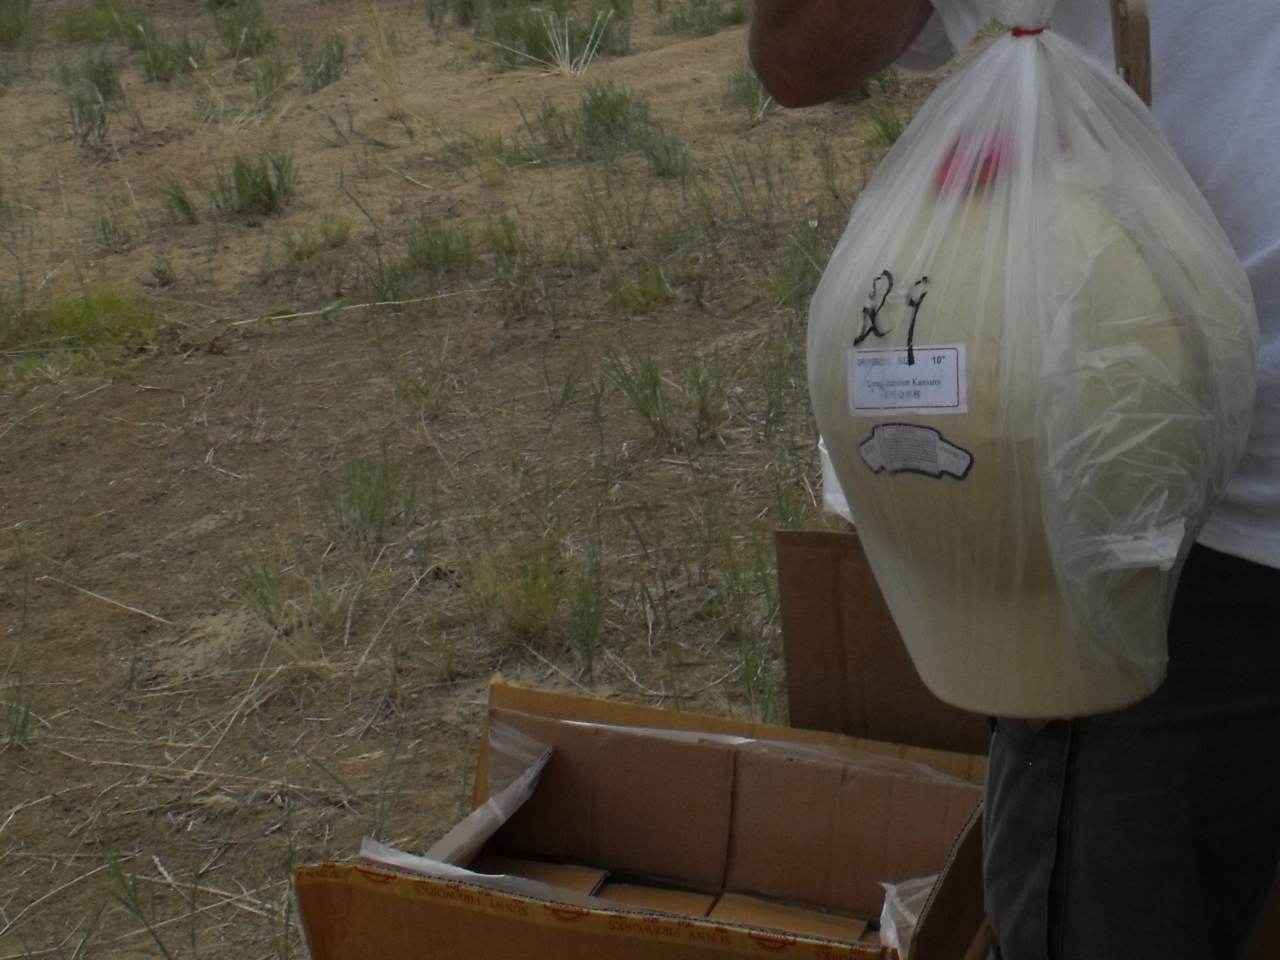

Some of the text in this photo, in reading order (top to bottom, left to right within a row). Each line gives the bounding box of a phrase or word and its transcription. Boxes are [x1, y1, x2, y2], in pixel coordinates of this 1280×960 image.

[415, 886, 529, 916] SUNNY FIREWORKS
[608, 918, 732, 945] SUNNY FIREWORKS
